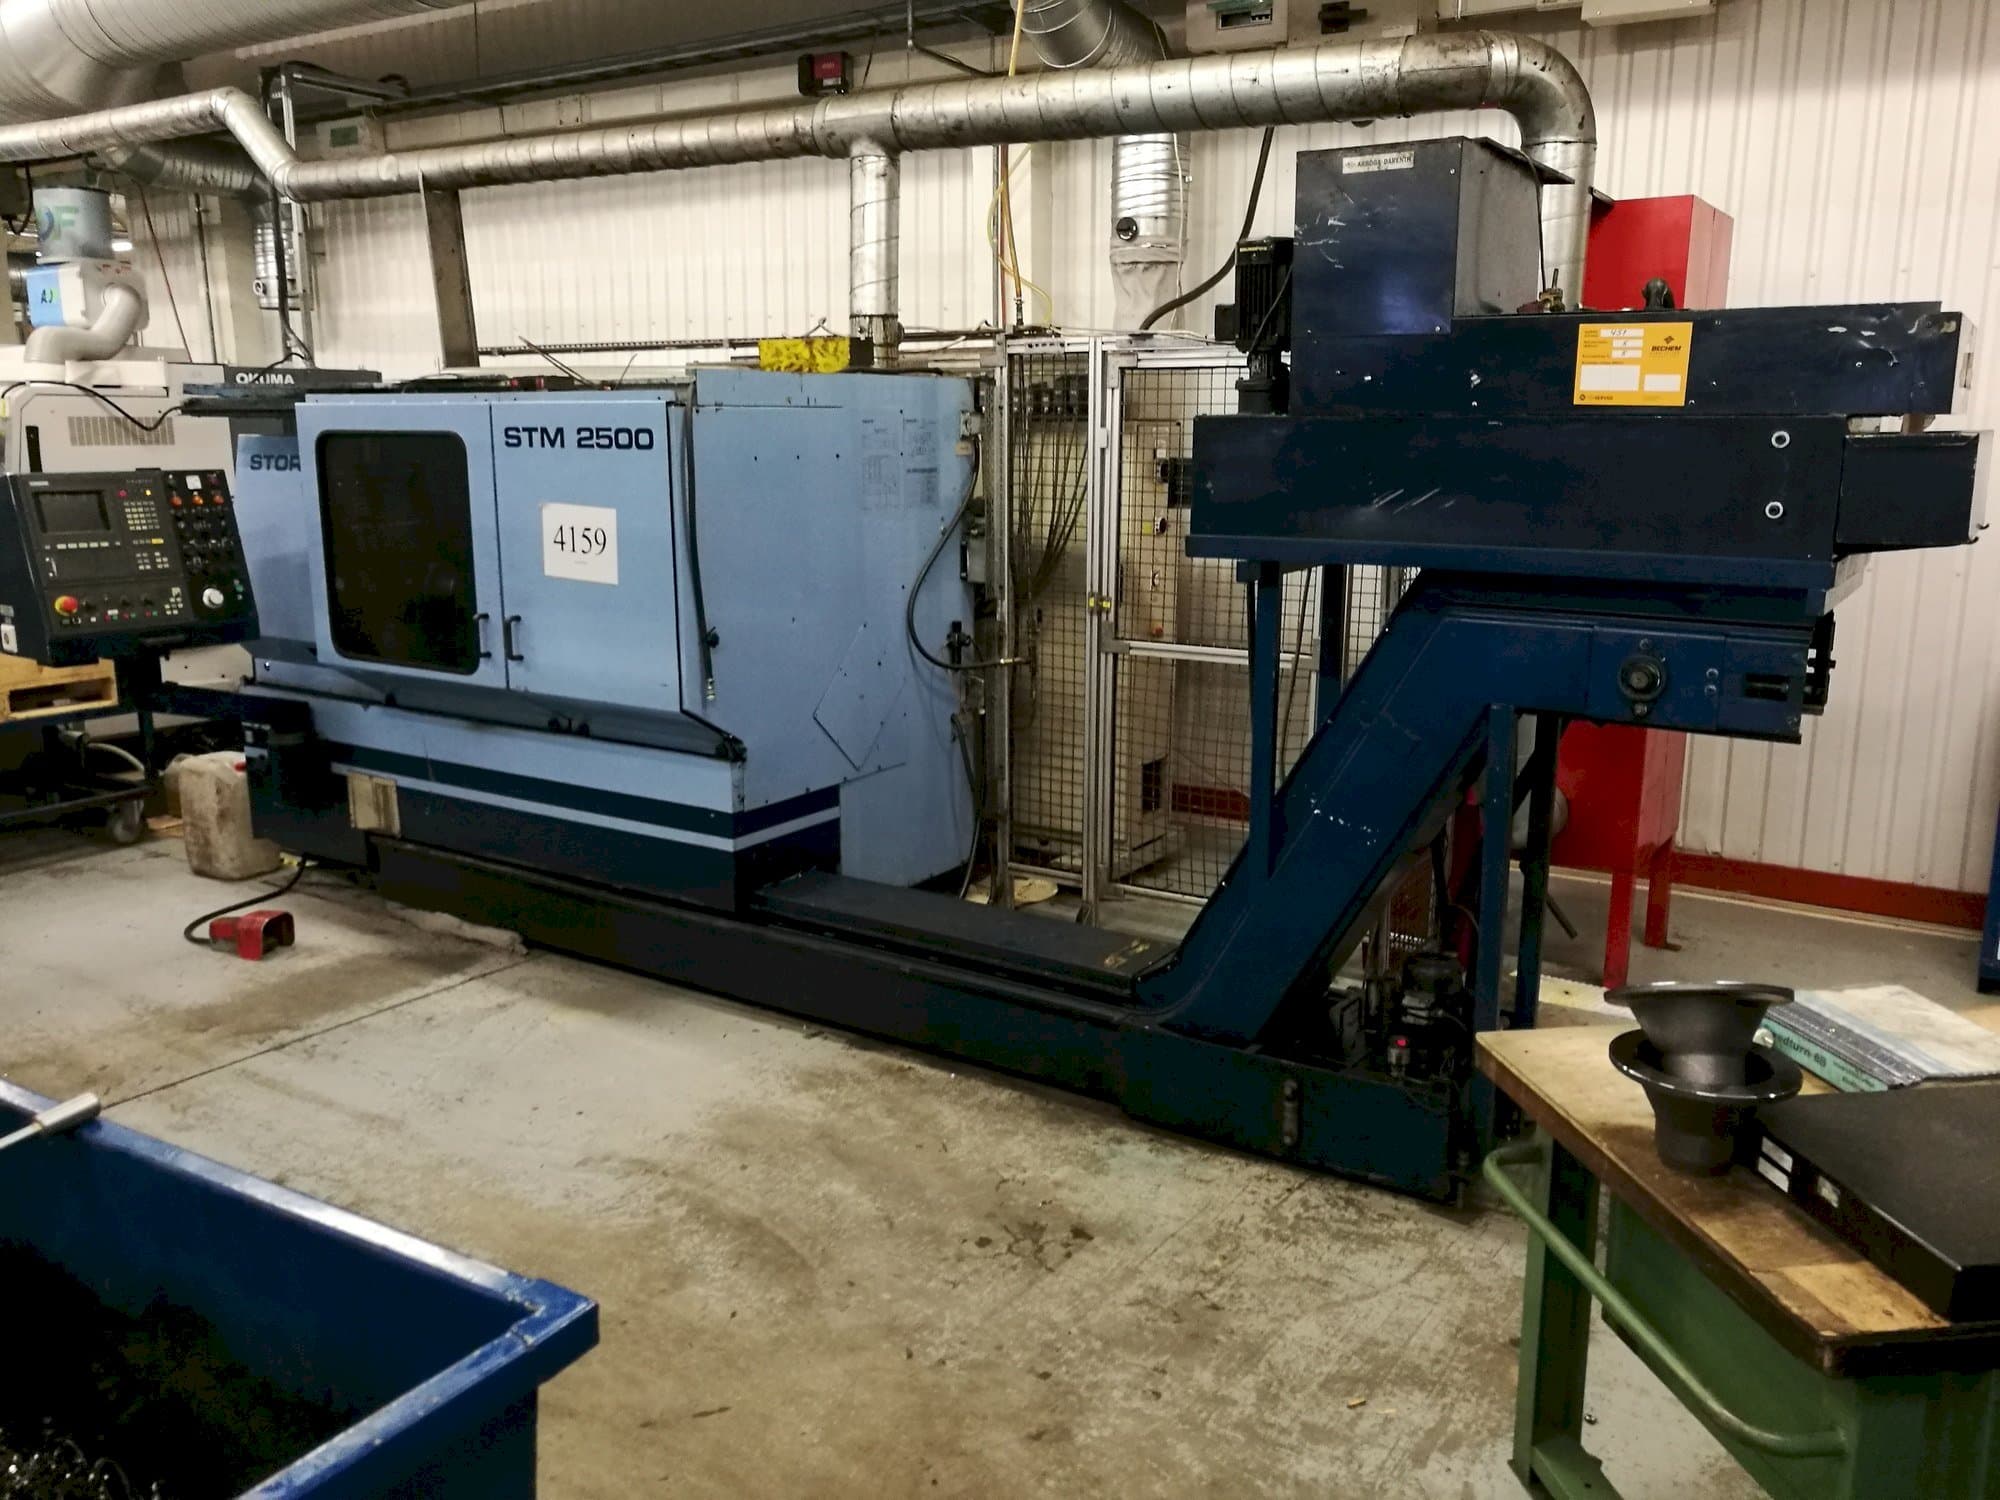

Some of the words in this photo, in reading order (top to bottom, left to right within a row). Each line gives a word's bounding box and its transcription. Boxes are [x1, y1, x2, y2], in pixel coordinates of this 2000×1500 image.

[503, 426, 565, 449] STM
[576, 427, 655, 451] 2500
[552, 524, 607, 556] 4159
